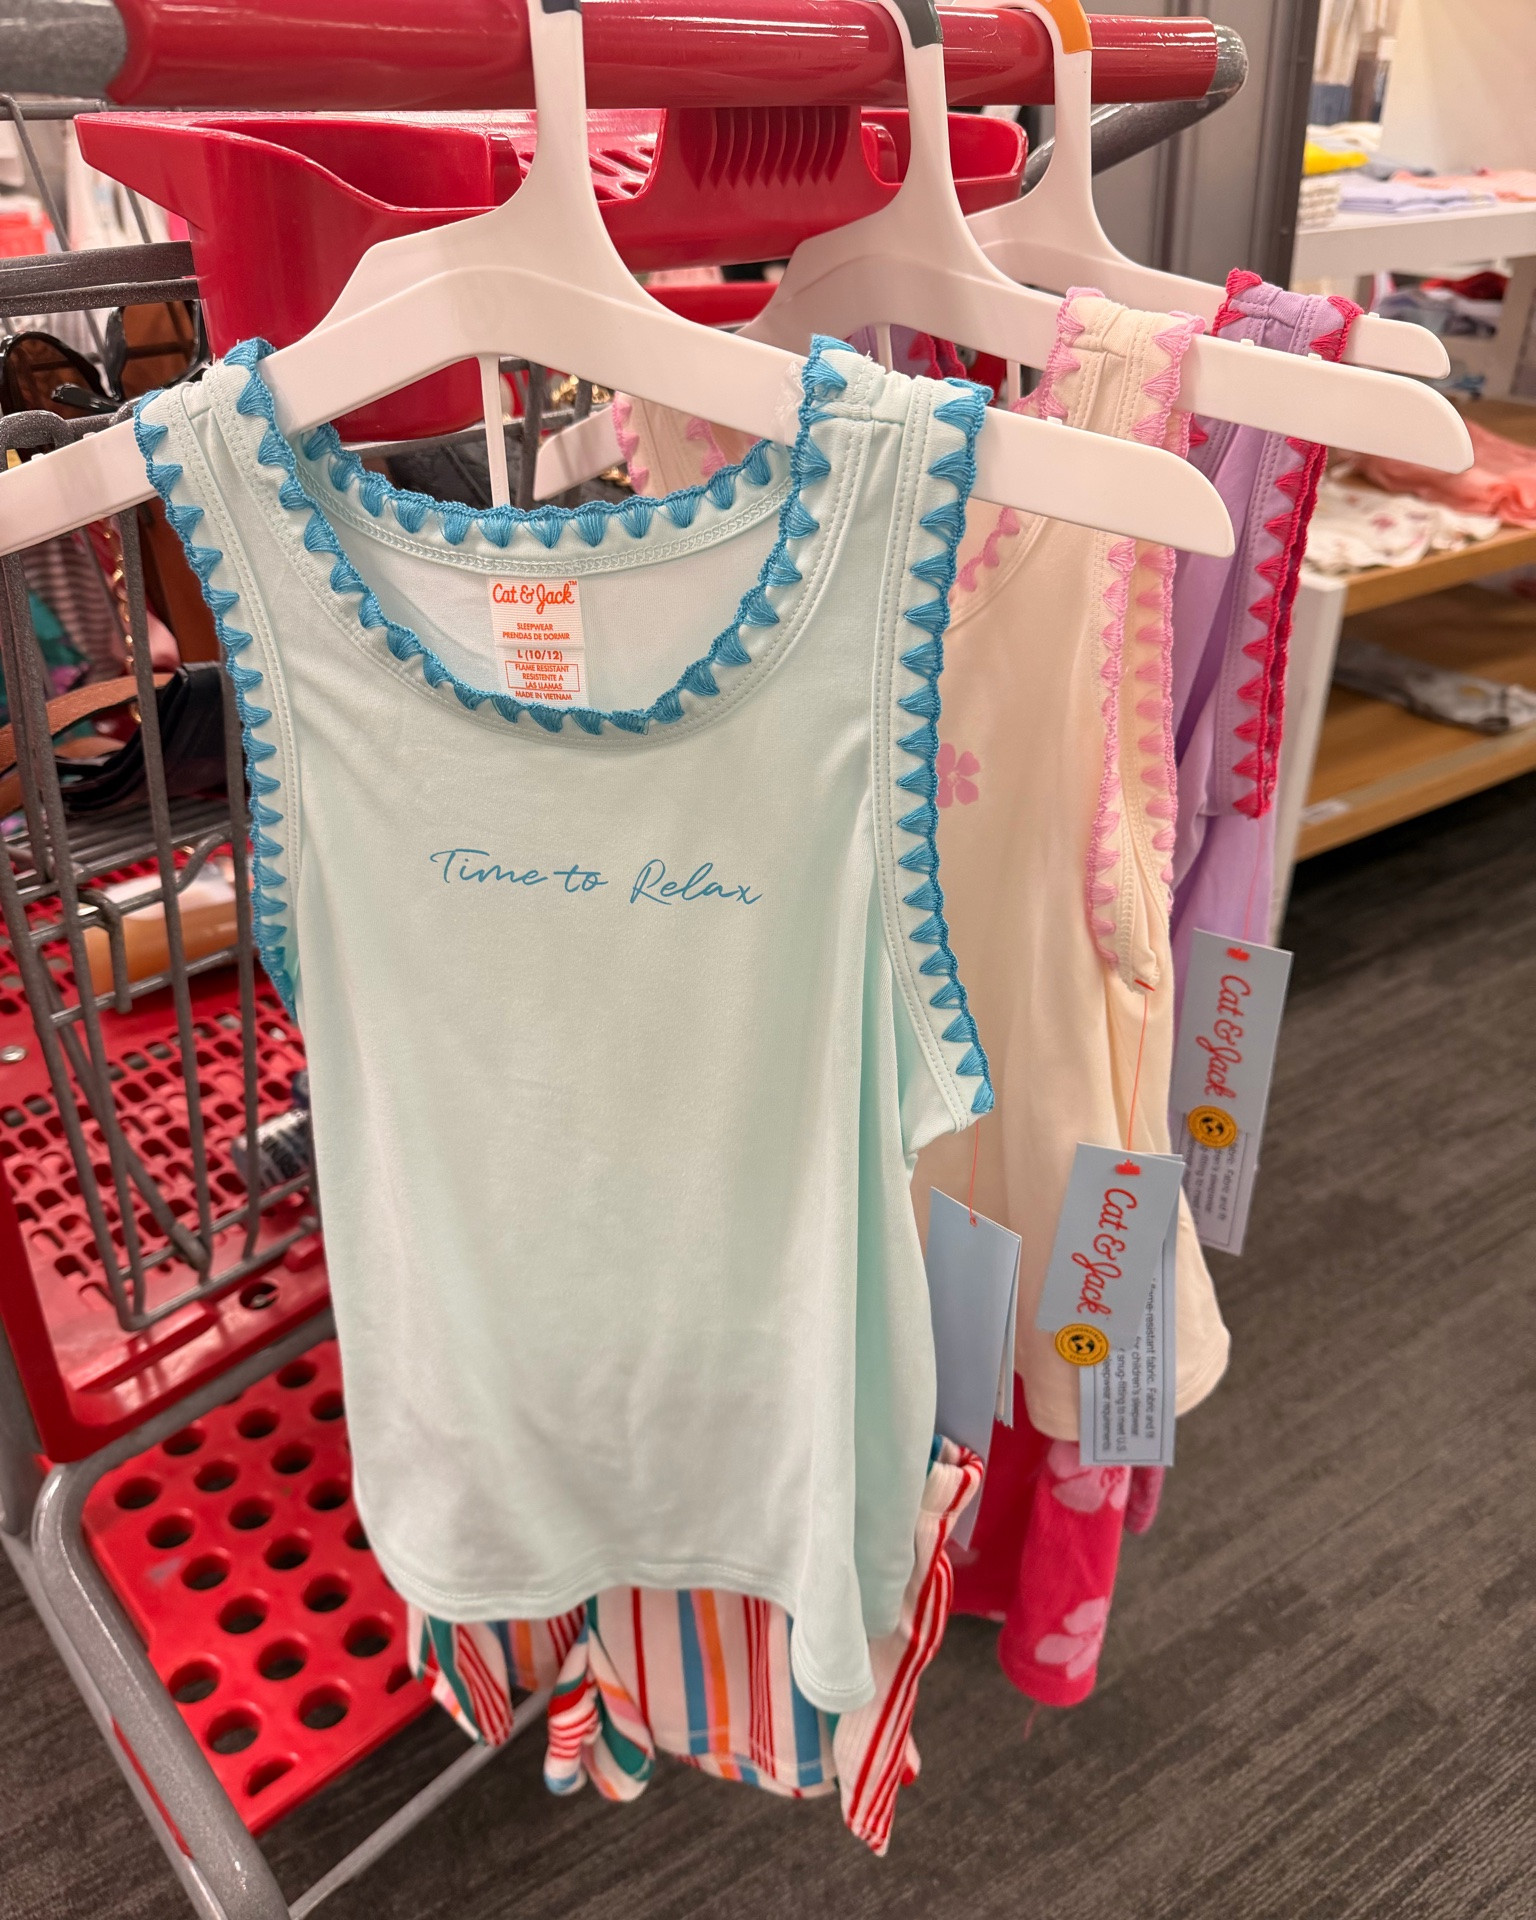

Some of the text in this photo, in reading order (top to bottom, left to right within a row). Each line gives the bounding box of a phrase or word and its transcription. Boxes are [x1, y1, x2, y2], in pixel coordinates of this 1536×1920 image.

[492, 583, 519, 604] Cat
[520, 584, 535, 605] &
[502, 631, 571, 641] PRENDAS DE DORMIR
[516, 622, 554, 632] SLEEPWEAR
[515, 663, 570, 673] FLAME RESISTANT
[517, 649, 563, 662] L (10/12)
[522, 672, 557, 681] RESISTENTE
[538, 682, 563, 690] LLAMAS
[515, 690, 535, 699] MADE
[543, 692, 573, 701] VIETNAM
[429, 848, 763, 905] Time to Relax
[1216, 974, 1253, 1017] Cat
[1213, 1018, 1244, 1047] &
[1194, 1035, 1243, 1100] Jack
[1098, 1187, 1138, 1231] Cat
[1092, 1233, 1126, 1261] &
[1071, 1251, 1123, 1316] Jack
[1131, 1351, 1142, 1395] children's
[1146, 1387, 1158, 1414] Fabric
